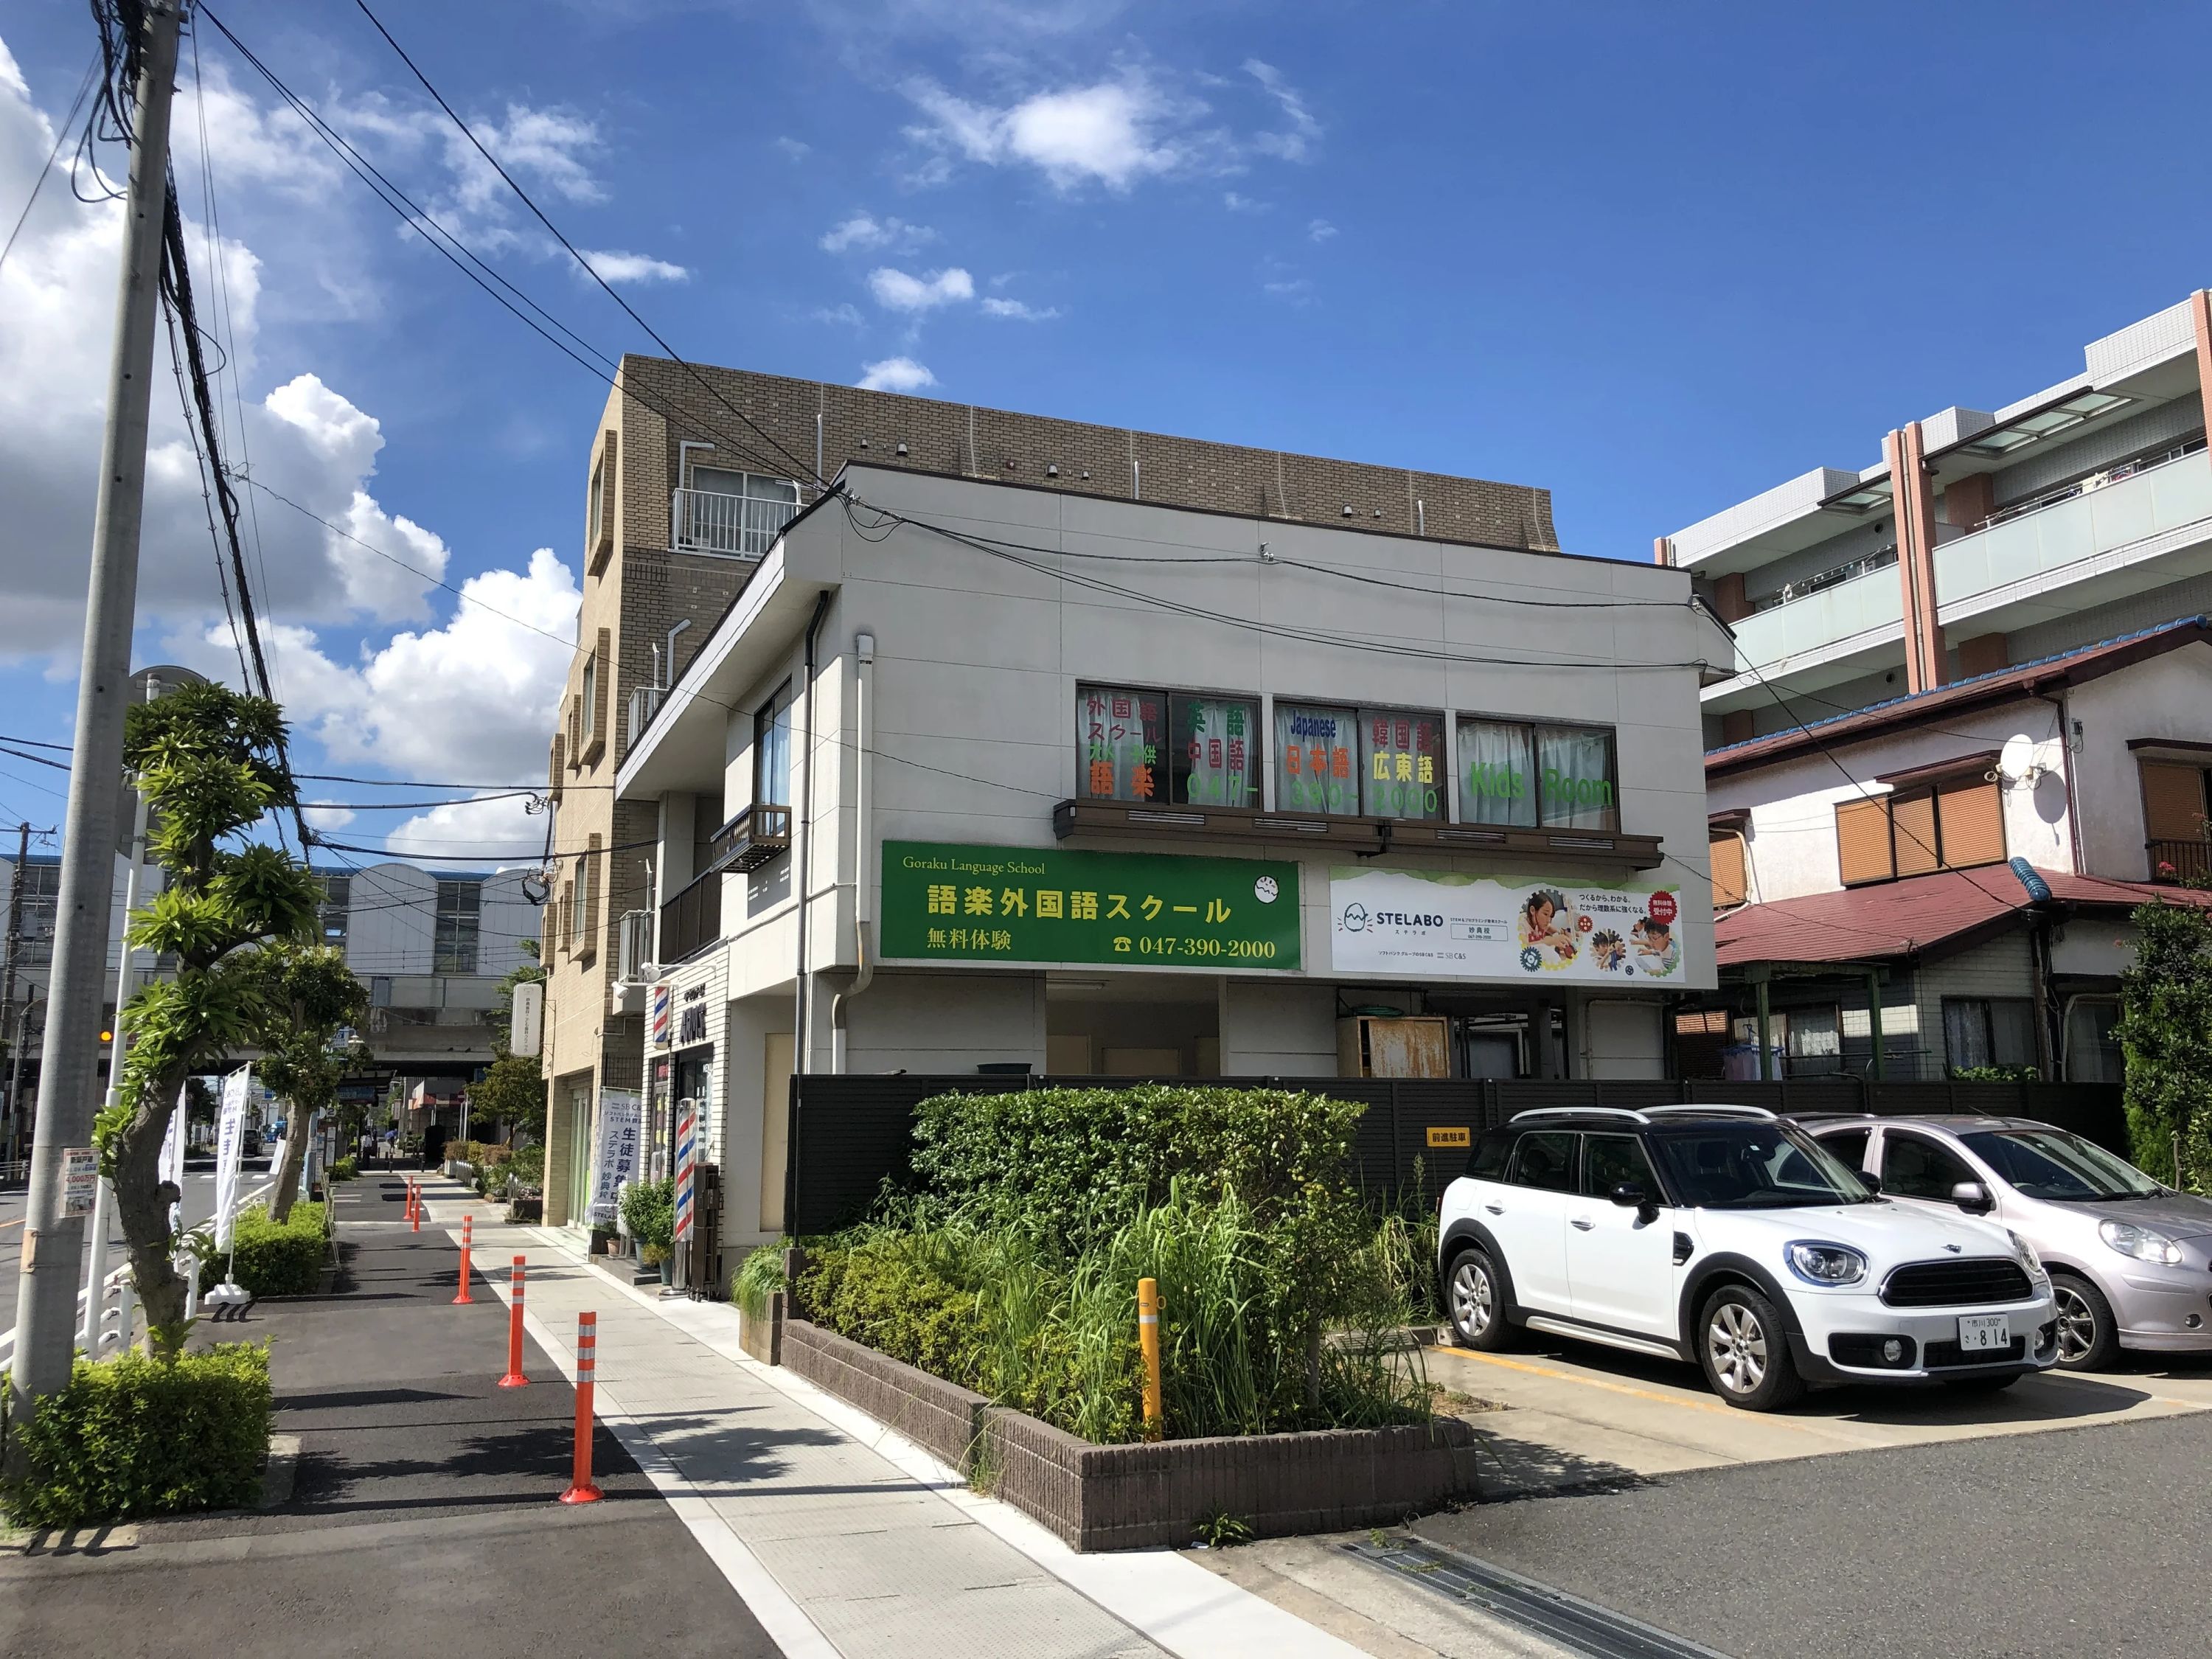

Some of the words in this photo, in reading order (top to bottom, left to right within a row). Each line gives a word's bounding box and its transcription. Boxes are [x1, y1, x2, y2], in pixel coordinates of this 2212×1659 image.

[1087, 695, 1157, 721] 外国語
[1187, 700, 1245, 736] 英語
[1088, 722, 1162, 743] スクール
[1290, 710, 1336, 742] Japanese
[1372, 718, 1433, 752] 韓国語
[1186, 737, 1245, 771] 中国語
[1287, 743, 1349, 779] 日本語
[1374, 751, 1433, 784] 広東語
[1090, 759, 1155, 798] 語楽
[1545, 768, 1613, 807] Room
[902, 855, 947, 870] Goraku
[951, 858, 1004, 875] Language
[1007, 862, 1046, 875] School
[928, 884, 1231, 924] 語楽外国語スクール
[1377, 912, 1443, 928] STELABO
[1653, 907, 1672, 916] 受付中
[927, 928, 1012, 950] 無料体験
[1139, 936, 1276, 959] 047-390-2000
[1432, 1132, 1467, 1142] 前進駐車
